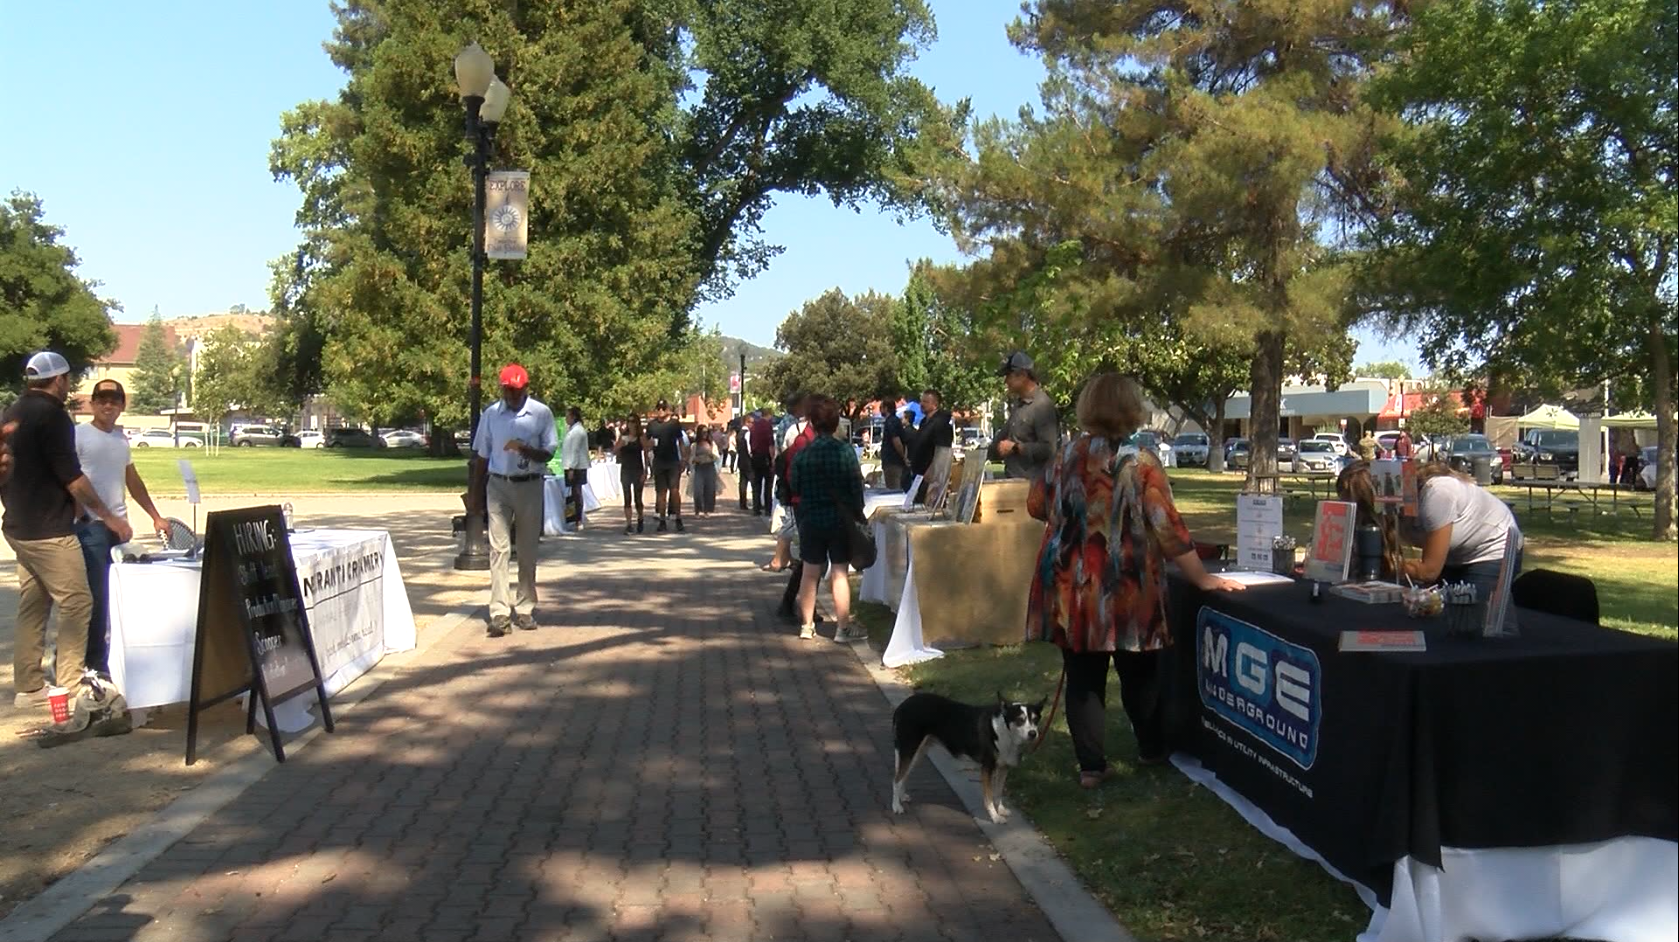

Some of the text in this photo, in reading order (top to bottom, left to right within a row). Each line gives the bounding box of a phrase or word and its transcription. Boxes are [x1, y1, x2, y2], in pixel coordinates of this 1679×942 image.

[489, 180, 526, 191] EXPLORE
[233, 519, 277, 556] HIRING:
[1203, 626, 1311, 722] MGE
[1205, 678, 1309, 750] UNDERGROUND
[1234, 740, 1258, 759] UTILITY
[1258, 755, 1314, 799] INFRASTRUCTURE
